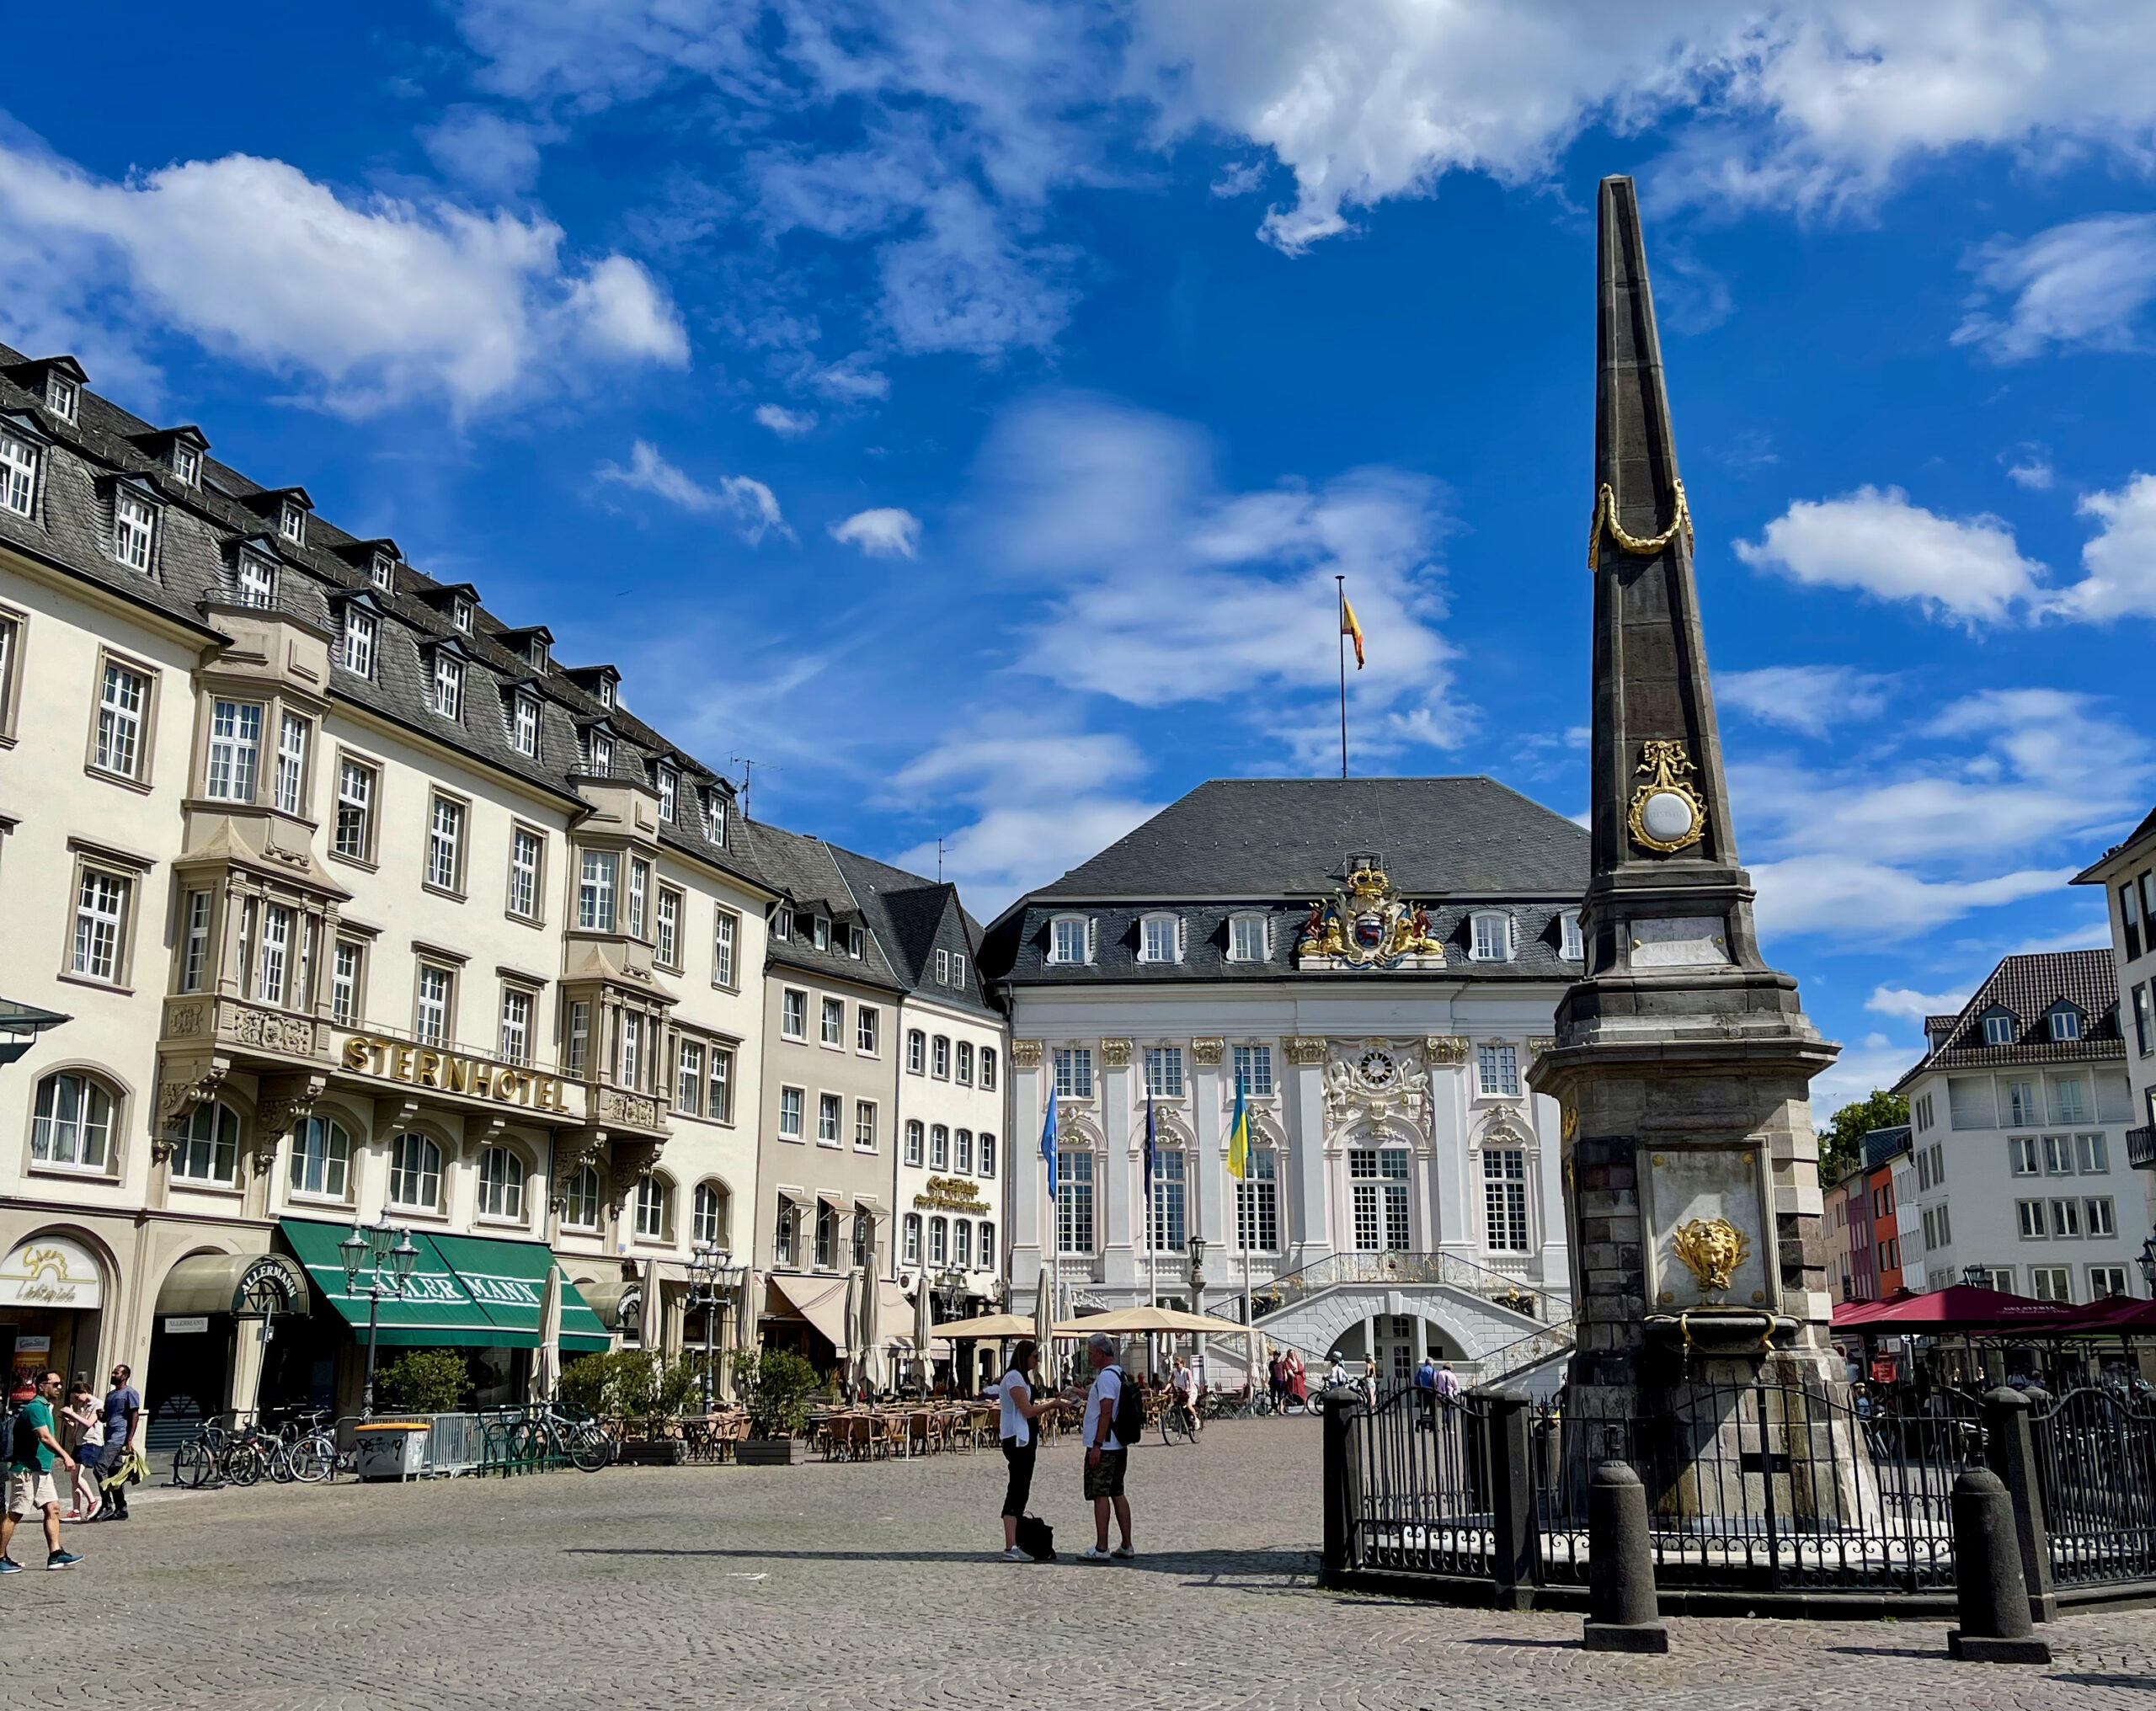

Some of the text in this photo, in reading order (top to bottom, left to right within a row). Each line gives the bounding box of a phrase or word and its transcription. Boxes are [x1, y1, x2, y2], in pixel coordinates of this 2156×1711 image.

[342, 1037, 570, 1112] STERNHOTEL
[241, 1265, 297, 1298] ALLERMANN
[371, 1275, 541, 1303] ALLER MANN
